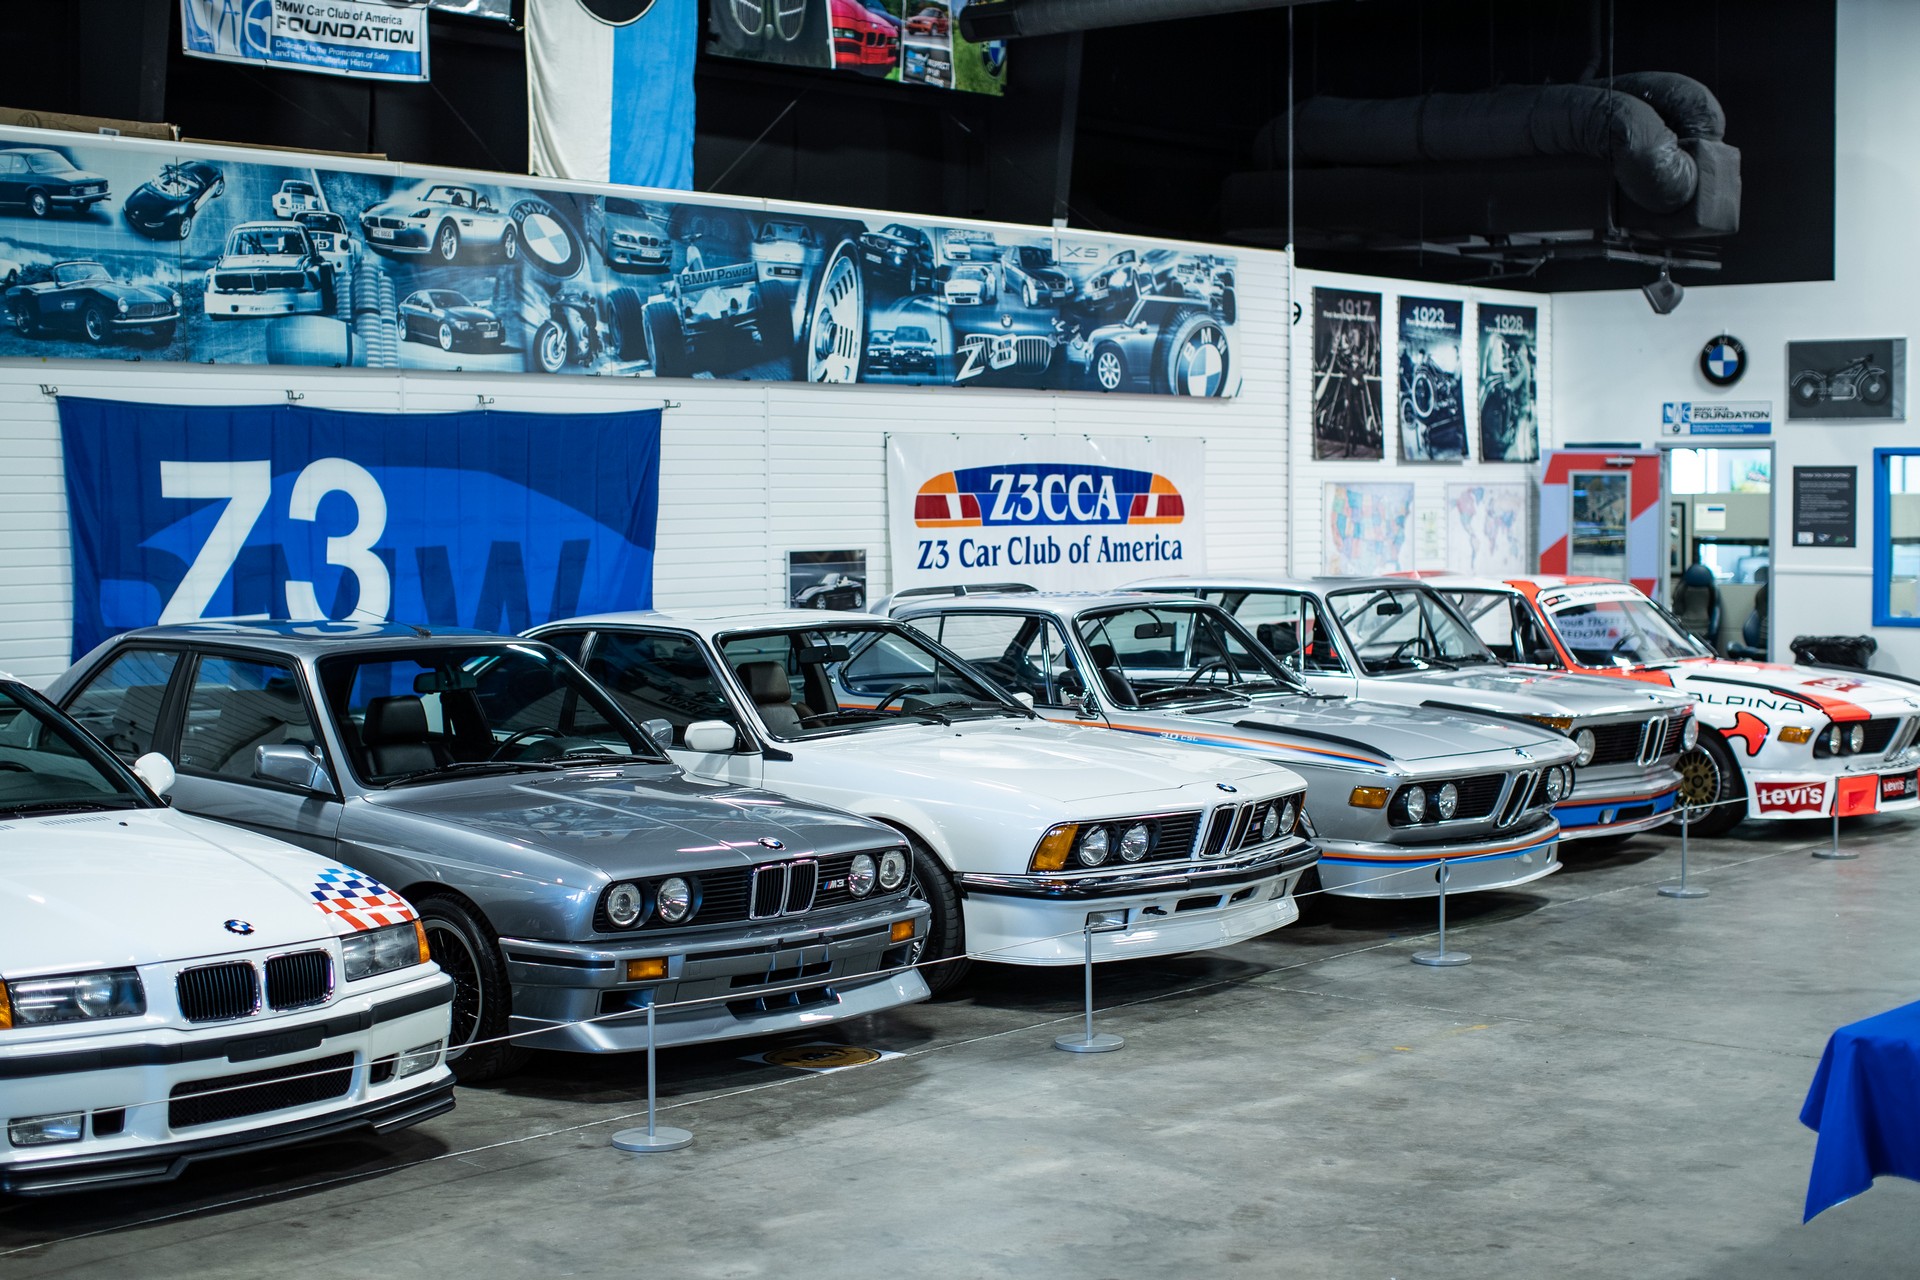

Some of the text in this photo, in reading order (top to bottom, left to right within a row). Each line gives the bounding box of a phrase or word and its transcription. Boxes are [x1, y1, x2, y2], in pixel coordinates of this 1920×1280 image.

[275, 1, 402, 25] BMW Car Club of America
[276, 14, 414, 45] FOUNDATION
[328, 47, 364, 58] Promotion
[350, 59, 373, 69] History
[513, 202, 550, 223] BMW
[1065, 246, 1099, 258] X5
[683, 265, 754, 287] BMW Power
[1338, 298, 1371, 316] 1917
[1412, 306, 1445, 328] 1923
[1494, 313, 1524, 334] 1928
[1182, 326, 1229, 363] BMW
[955, 332, 1018, 382] Z8
[1693, 410, 1769, 420] FOUNDATION
[988, 473, 1121, 521] Z3CCA
[158, 457, 391, 626] Z3
[916, 534, 1183, 570] Z3 Car Club of America
[1687, 692, 1805, 714] ALPINA
[1760, 787, 1823, 806] Levi's
[826, 879, 845, 889] M3
